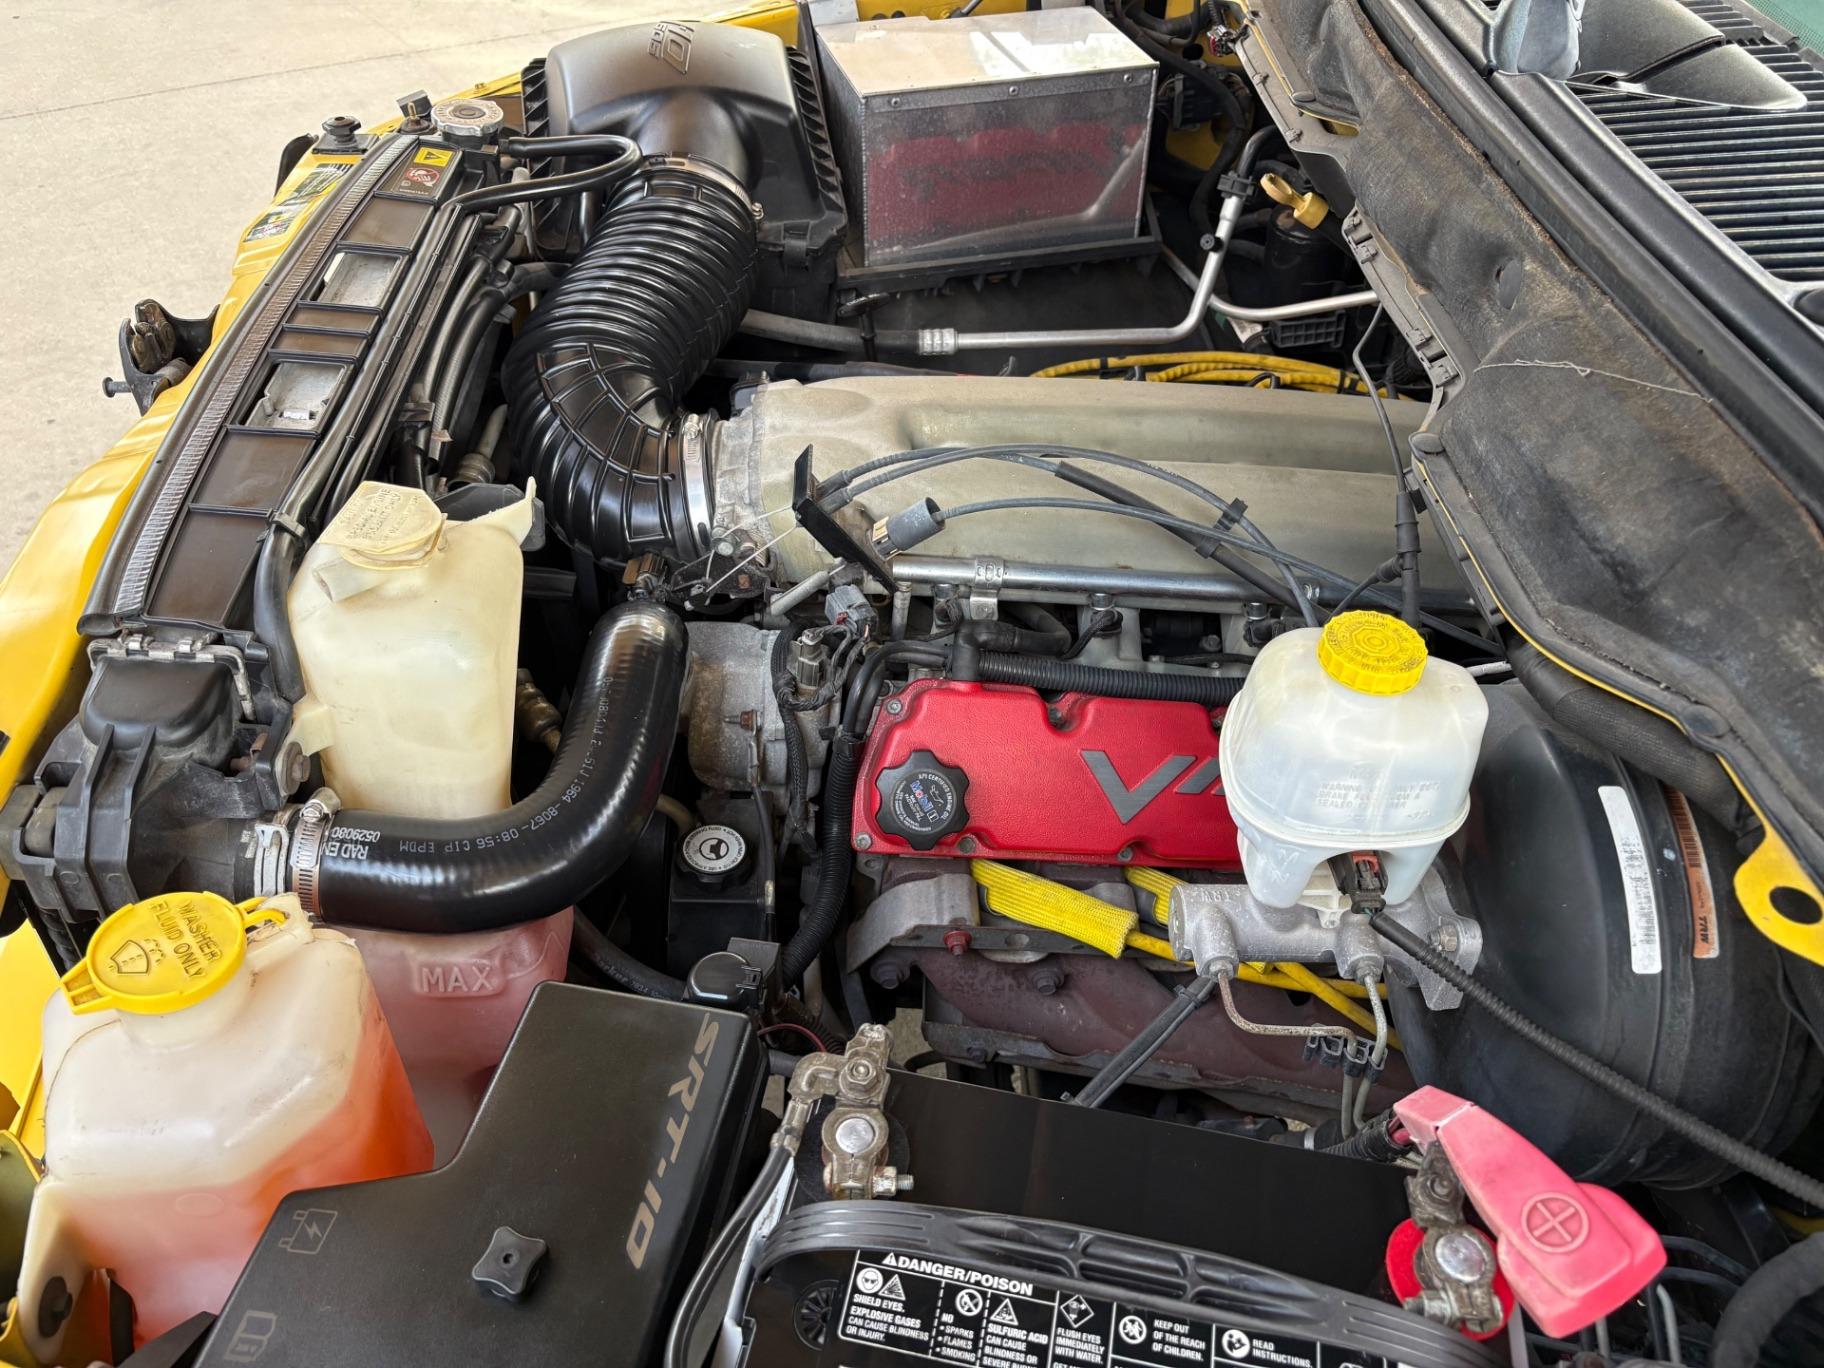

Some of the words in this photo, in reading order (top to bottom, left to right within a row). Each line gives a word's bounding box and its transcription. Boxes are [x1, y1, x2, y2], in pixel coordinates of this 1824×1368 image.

[331, 826, 381, 843] 0529080
[476, 828, 520, 850] 08:56
[341, 843, 369, 860] RAD
[400, 840, 435, 853] EPDM
[149, 901, 183, 942] FLUID
[173, 943, 207, 977] ONLY
[177, 899, 223, 962] WASHER
[420, 966, 495, 994] MAX
[627, 1013, 719, 1269] SRT-10
[898, 1256, 1034, 1296] DANGER/POISON
[853, 1294, 881, 1307] SHIELD
[882, 1300, 905, 1313] EYES.
[851, 1305, 895, 1323] EXPLOSIVE
[894, 1314, 921, 1329] GASES
[941, 1312, 954, 1324] NO
[1153, 1319, 1173, 1331] KEEP
[1173, 1322, 1190, 1334] OUT
[846, 1325, 857, 1334] OR
[857, 1327, 886, 1342] INJURY.
[848, 1316, 863, 1328] CAN
[864, 1319, 889, 1332] CAUSE
[889, 1324, 930, 1341] BLINDNESS
[987, 1323, 1028, 1340] SULFURIC
[1028, 1332, 1049, 1345] ACID
[1056, 1327, 1081, 1339] FLUSH
[1082, 1332, 1101, 1344] EYES
[986, 1334, 1000, 1345] CAN
[1002, 1338, 1027, 1351] CAUSE
[1056, 1336, 1105, 1355] IMMEDIATELY
[1153, 1331, 1165, 1340] OF
[1165, 1333, 1180, 1344] THE
[1180, 1336, 1206, 1350] REACH
[1252, 1338, 1275, 1351] READ
[984, 1345, 1025, 1362] BLINDNESS
[1026, 1354, 1038, 1365] OR
[1055, 1346, 1075, 1357] WITH
[1075, 1350, 1103, 1365] WATER.
[1152, 1342, 1163, 1352] OF
[1164, 1344, 1204, 1362] CHILDREN.
[1252, 1349, 1313, 1368] INSTRUCTIONS.
